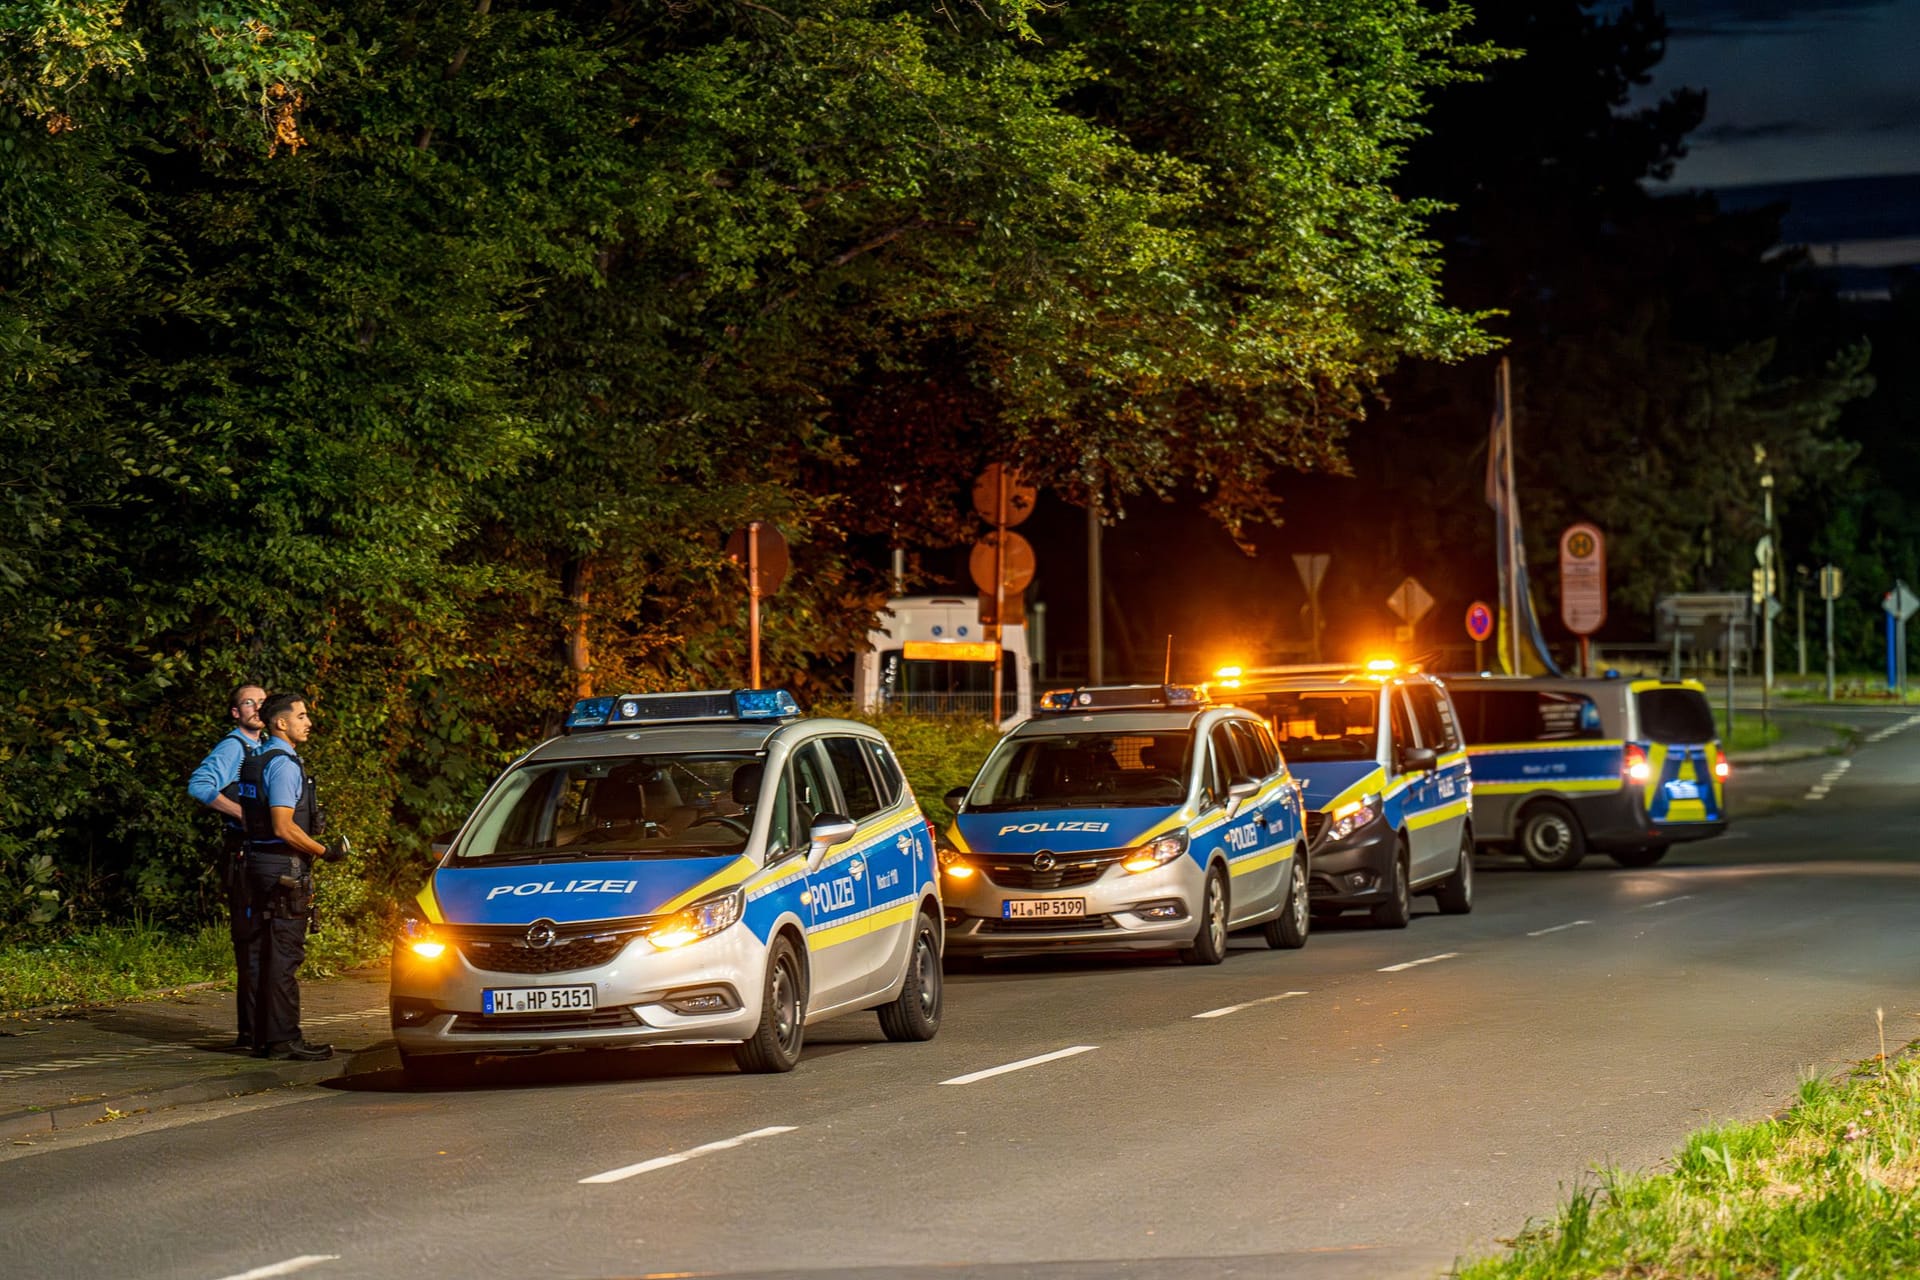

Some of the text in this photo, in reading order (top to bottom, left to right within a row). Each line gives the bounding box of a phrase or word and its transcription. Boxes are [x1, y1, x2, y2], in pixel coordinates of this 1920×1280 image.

[998, 821, 1110, 836] POLIZEI
[1229, 822, 1258, 852] POLIZEI
[486, 879, 638, 901] POLIZEI
[810, 876, 855, 916] POLIZEI
[1011, 901, 1082, 916] WI HP 5199
[495, 989, 592, 1011] WI HP 5151
